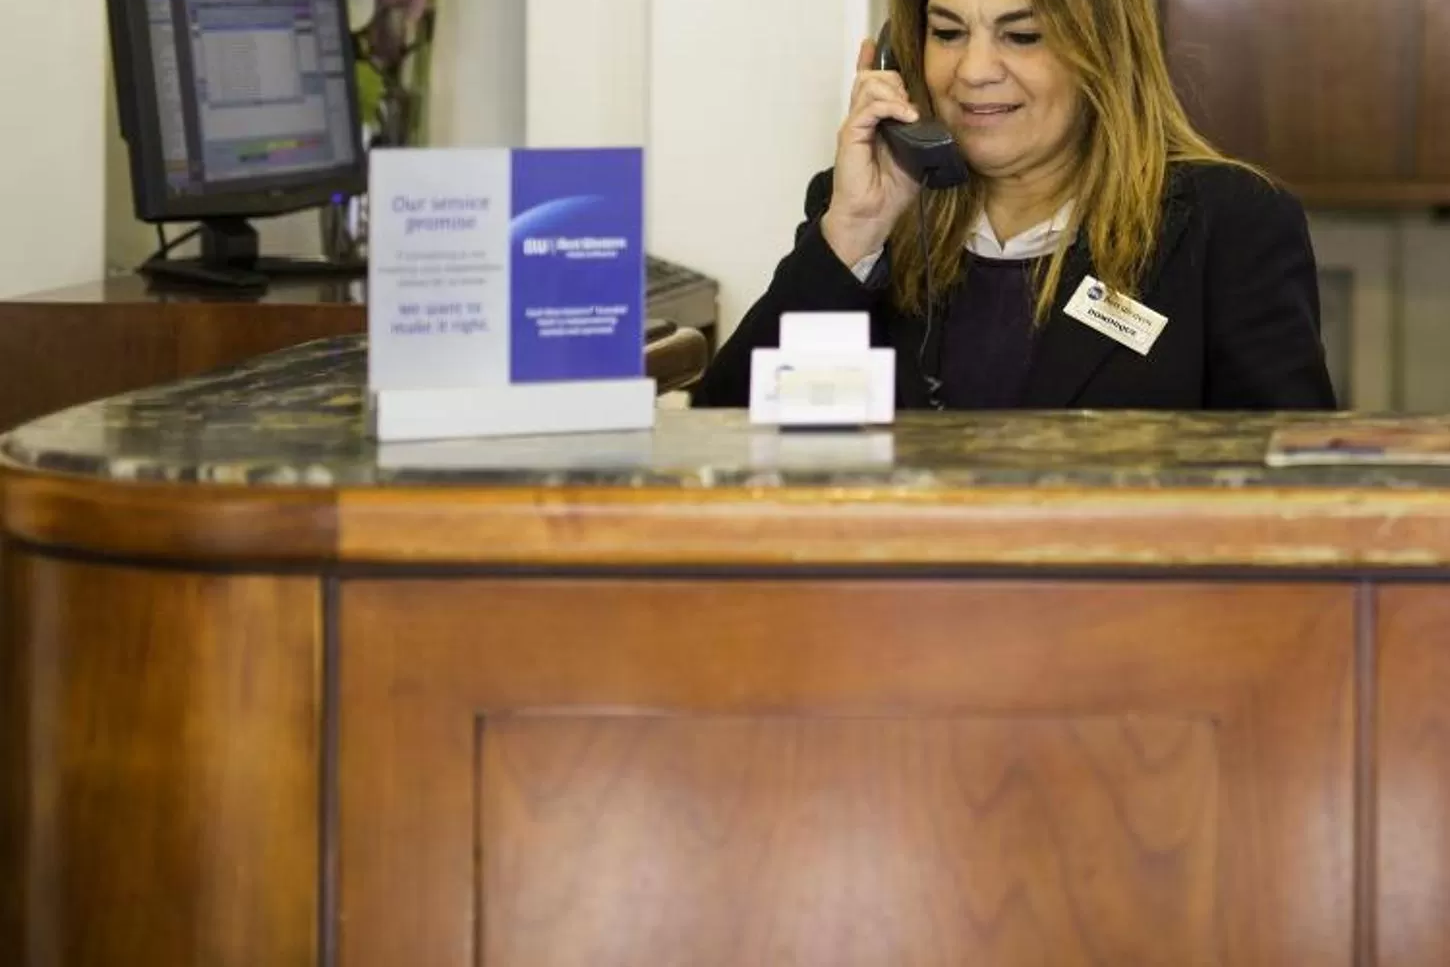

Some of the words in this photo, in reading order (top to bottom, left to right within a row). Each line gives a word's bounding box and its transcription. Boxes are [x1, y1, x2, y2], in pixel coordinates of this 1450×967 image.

[392, 195, 426, 213] Our
[431, 194, 490, 211] service
[405, 216, 477, 234] promise
